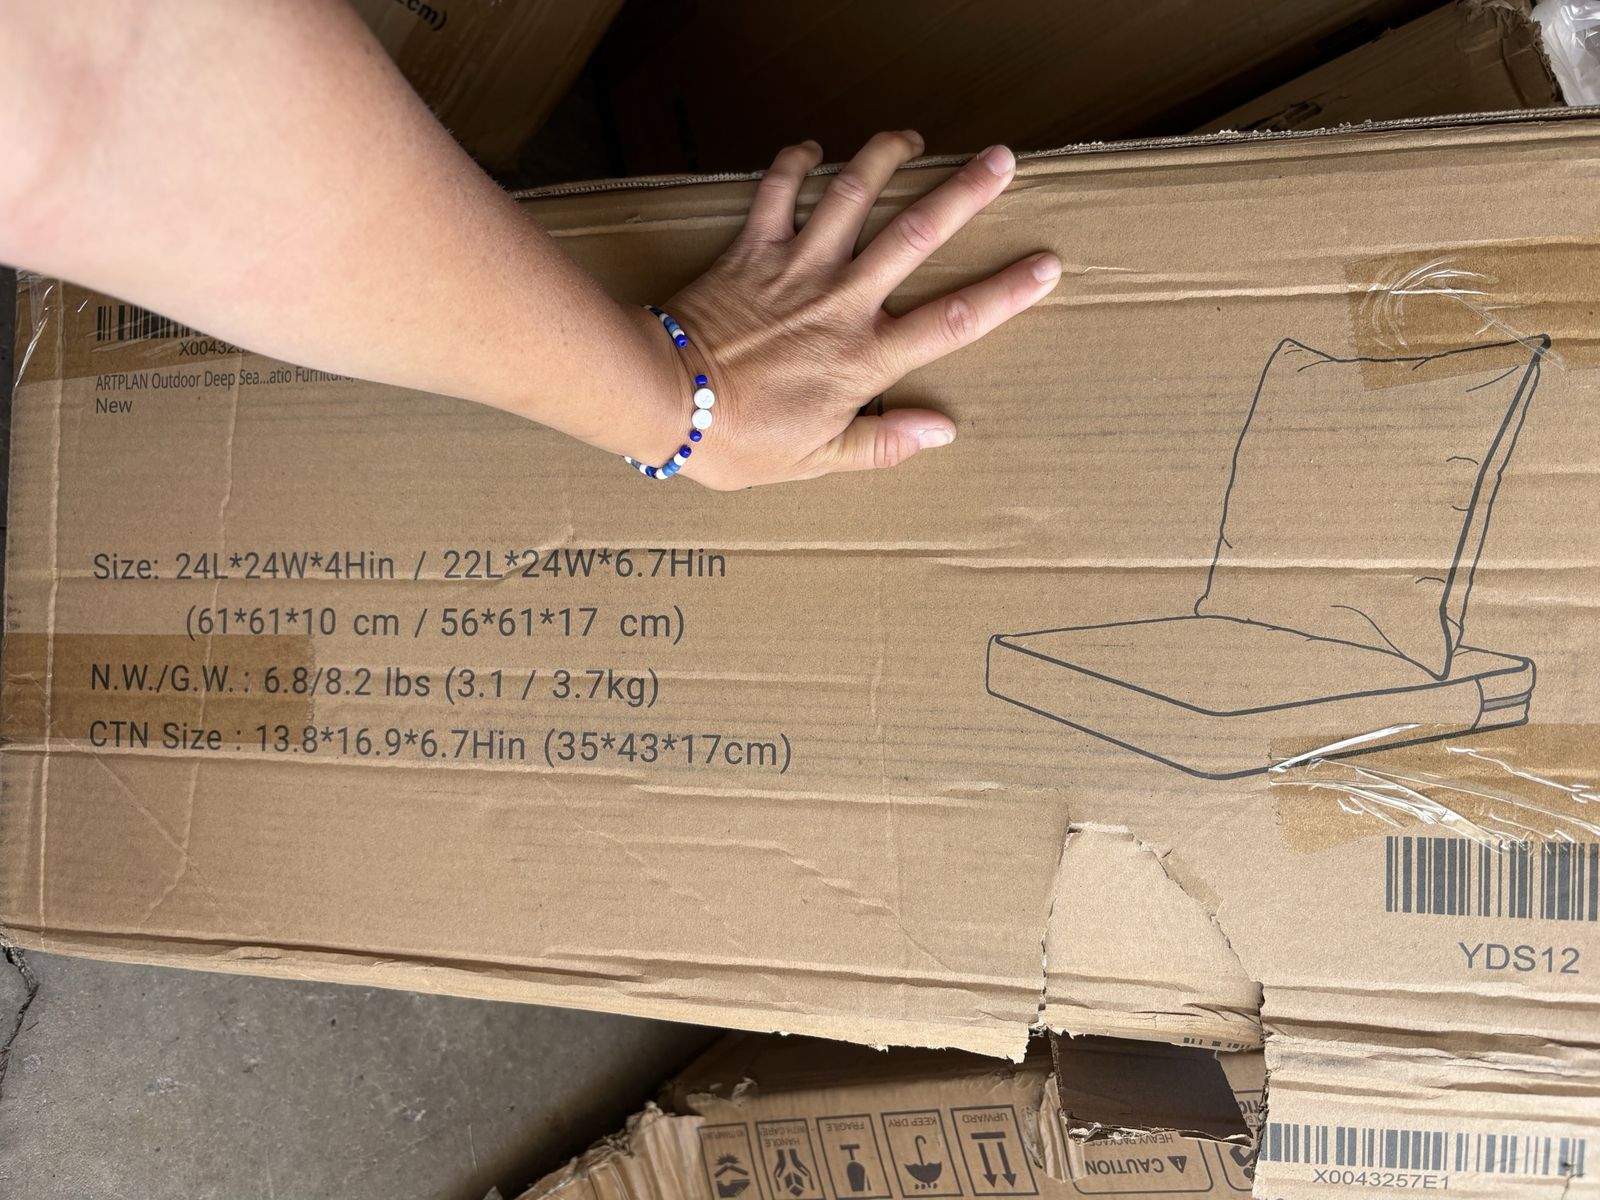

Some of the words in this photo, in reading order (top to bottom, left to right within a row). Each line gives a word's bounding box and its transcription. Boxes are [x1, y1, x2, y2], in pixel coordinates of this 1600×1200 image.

[397, 0, 447, 31] cm)
[95, 374, 148, 393] ARTPLAN
[151, 371, 201, 389] Outdoor
[204, 369, 235, 391] Deep
[95, 397, 133, 415] New
[93, 553, 160, 580] Size:
[413, 551, 427, 581] /
[353, 614, 400, 636] cm
[414, 608, 428, 638] /
[619, 605, 685, 645] cm)
[264, 667, 372, 697] 6.8/8.2
[385, 667, 431, 697] lbs
[445, 667, 504, 705] (3.1
[521, 670, 537, 700] /
[552, 669, 660, 708] 3.7kg)
[90, 721, 149, 749] CTN
[162, 723, 222, 750] Size
[1458, 942, 1580, 975] YDS12
[825, 1120, 865, 1131] FRAGILE
[888, 1117, 910, 1128] DRY
[912, 1114, 937, 1126] KEEP
[961, 1111, 1009, 1123] UPWARD
[1084, 1158, 1165, 1176] CAUTION
[1313, 1168, 1449, 1190] X0043257E1
